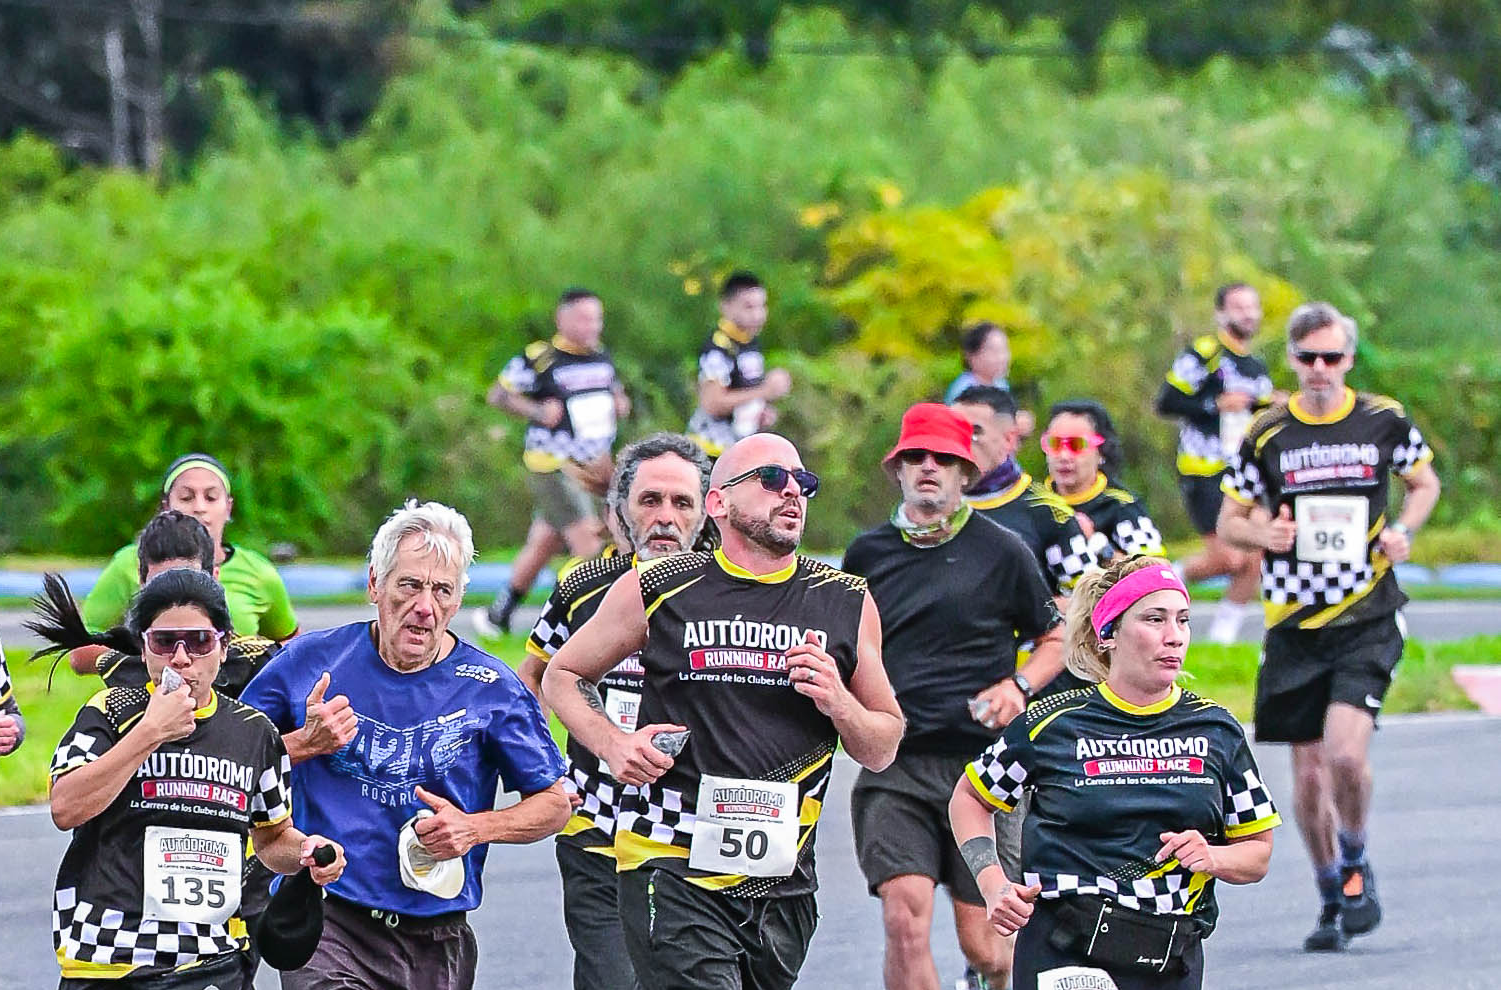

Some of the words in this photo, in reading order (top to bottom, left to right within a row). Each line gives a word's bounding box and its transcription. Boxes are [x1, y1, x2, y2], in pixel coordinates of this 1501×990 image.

[1315, 530, 1345, 551] 96
[704, 651, 763, 668] RUNNING
[767, 653, 786, 670] RA
[679, 672, 688, 681] La
[689, 672, 720, 682] Carrera
[721, 673, 732, 682] de
[733, 674, 746, 683] los
[747, 675, 775, 686] Clubes
[1076, 734, 1209, 760] AUTÓDROMO
[136, 748, 253, 792] AUTÓDROMO
[1098, 759, 1154, 773] RUNNING
[1158, 759, 1190, 771] RACE
[156, 782, 209, 798] RUNNING
[212, 786, 240, 806] RACE
[713, 785, 785, 808] AUTÓDROMO
[130, 800, 139, 808] La
[140, 800, 168, 810] Carrera
[170, 803, 180, 811] de
[181, 804, 191, 813] los
[193, 805, 217, 816] Clubes
[219, 808, 229, 818] del
[160, 834, 229, 857] AUTÓDROMO
[719, 827, 768, 860] 50
[161, 876, 225, 908] 135
